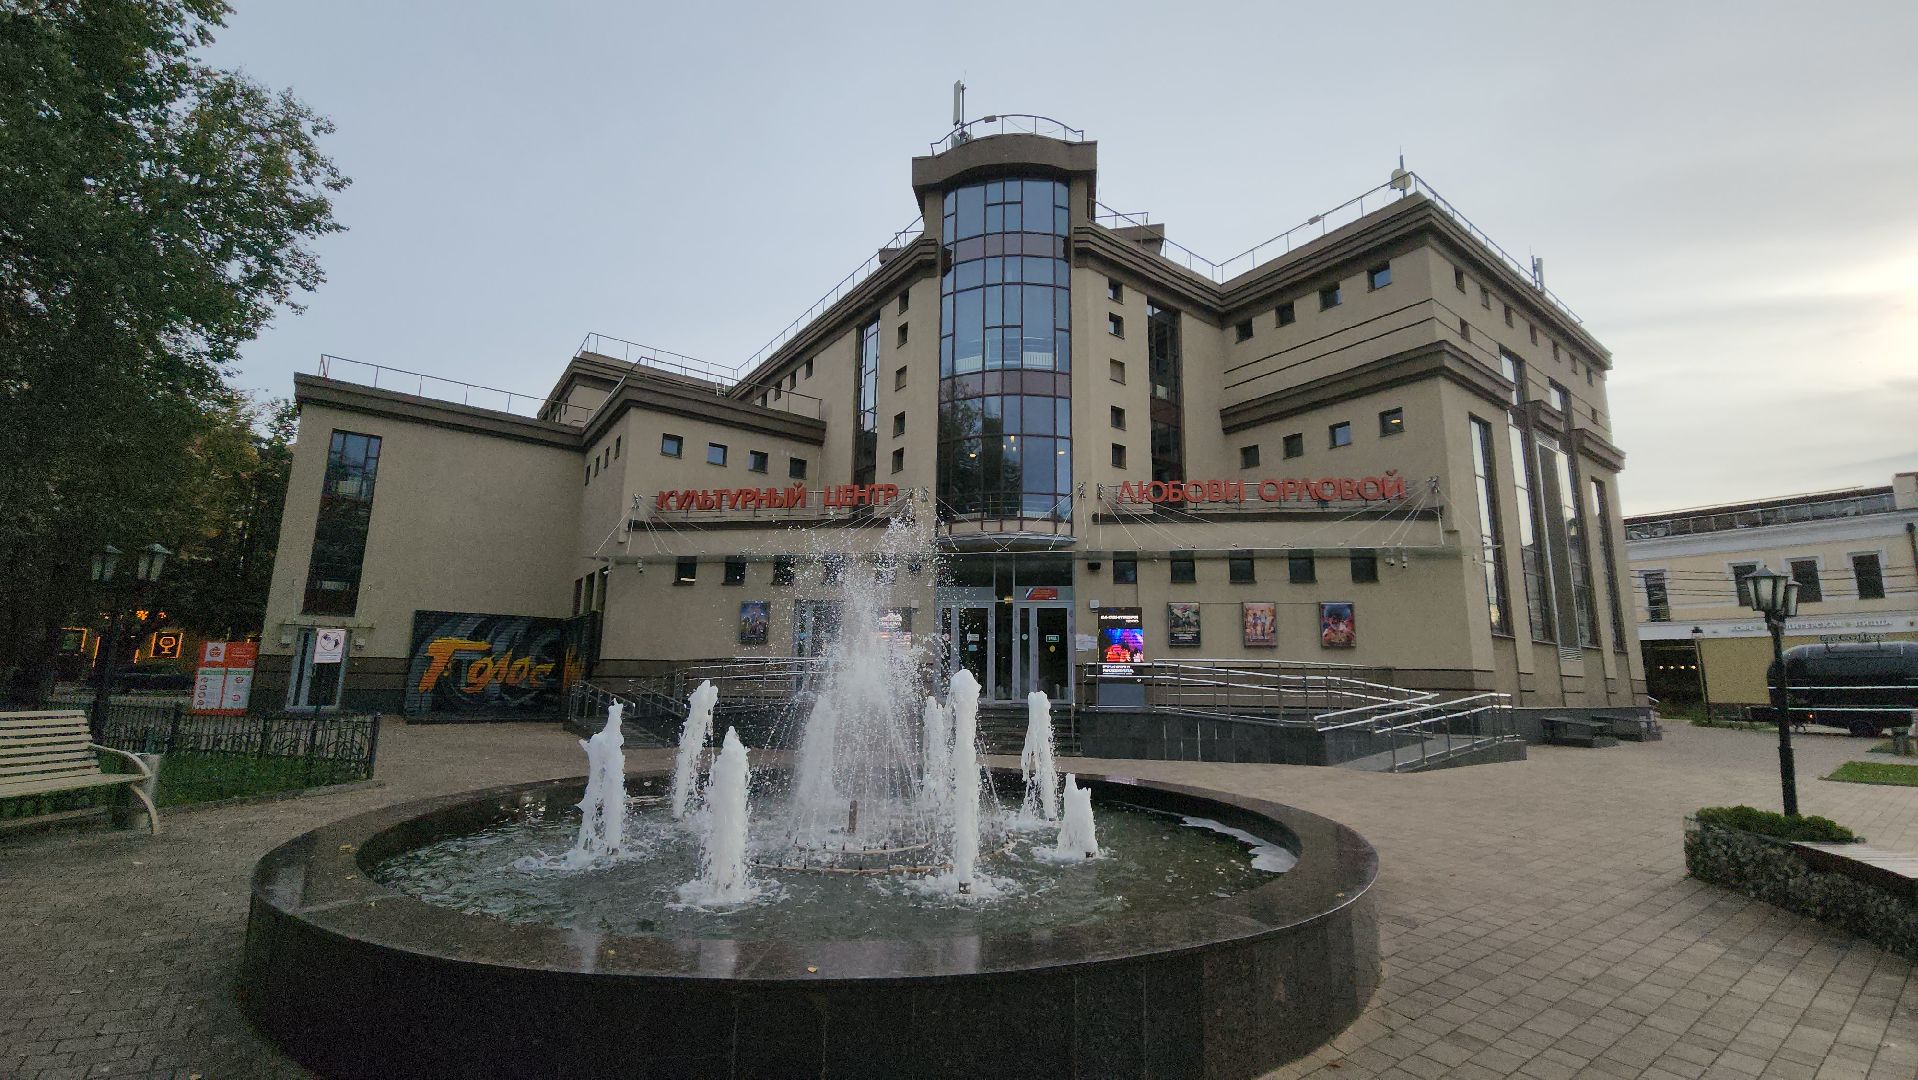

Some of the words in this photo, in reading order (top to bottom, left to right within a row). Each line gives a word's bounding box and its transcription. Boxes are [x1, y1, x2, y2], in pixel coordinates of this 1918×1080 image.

[657, 482, 807, 510] КУЛЬТУРНЫЙ
[823, 484, 898, 510] ЦЕНТР
[1118, 480, 1246, 503] ЛЮБОВИ
[1258, 469, 1405, 502] ОРЛОВОЙ
